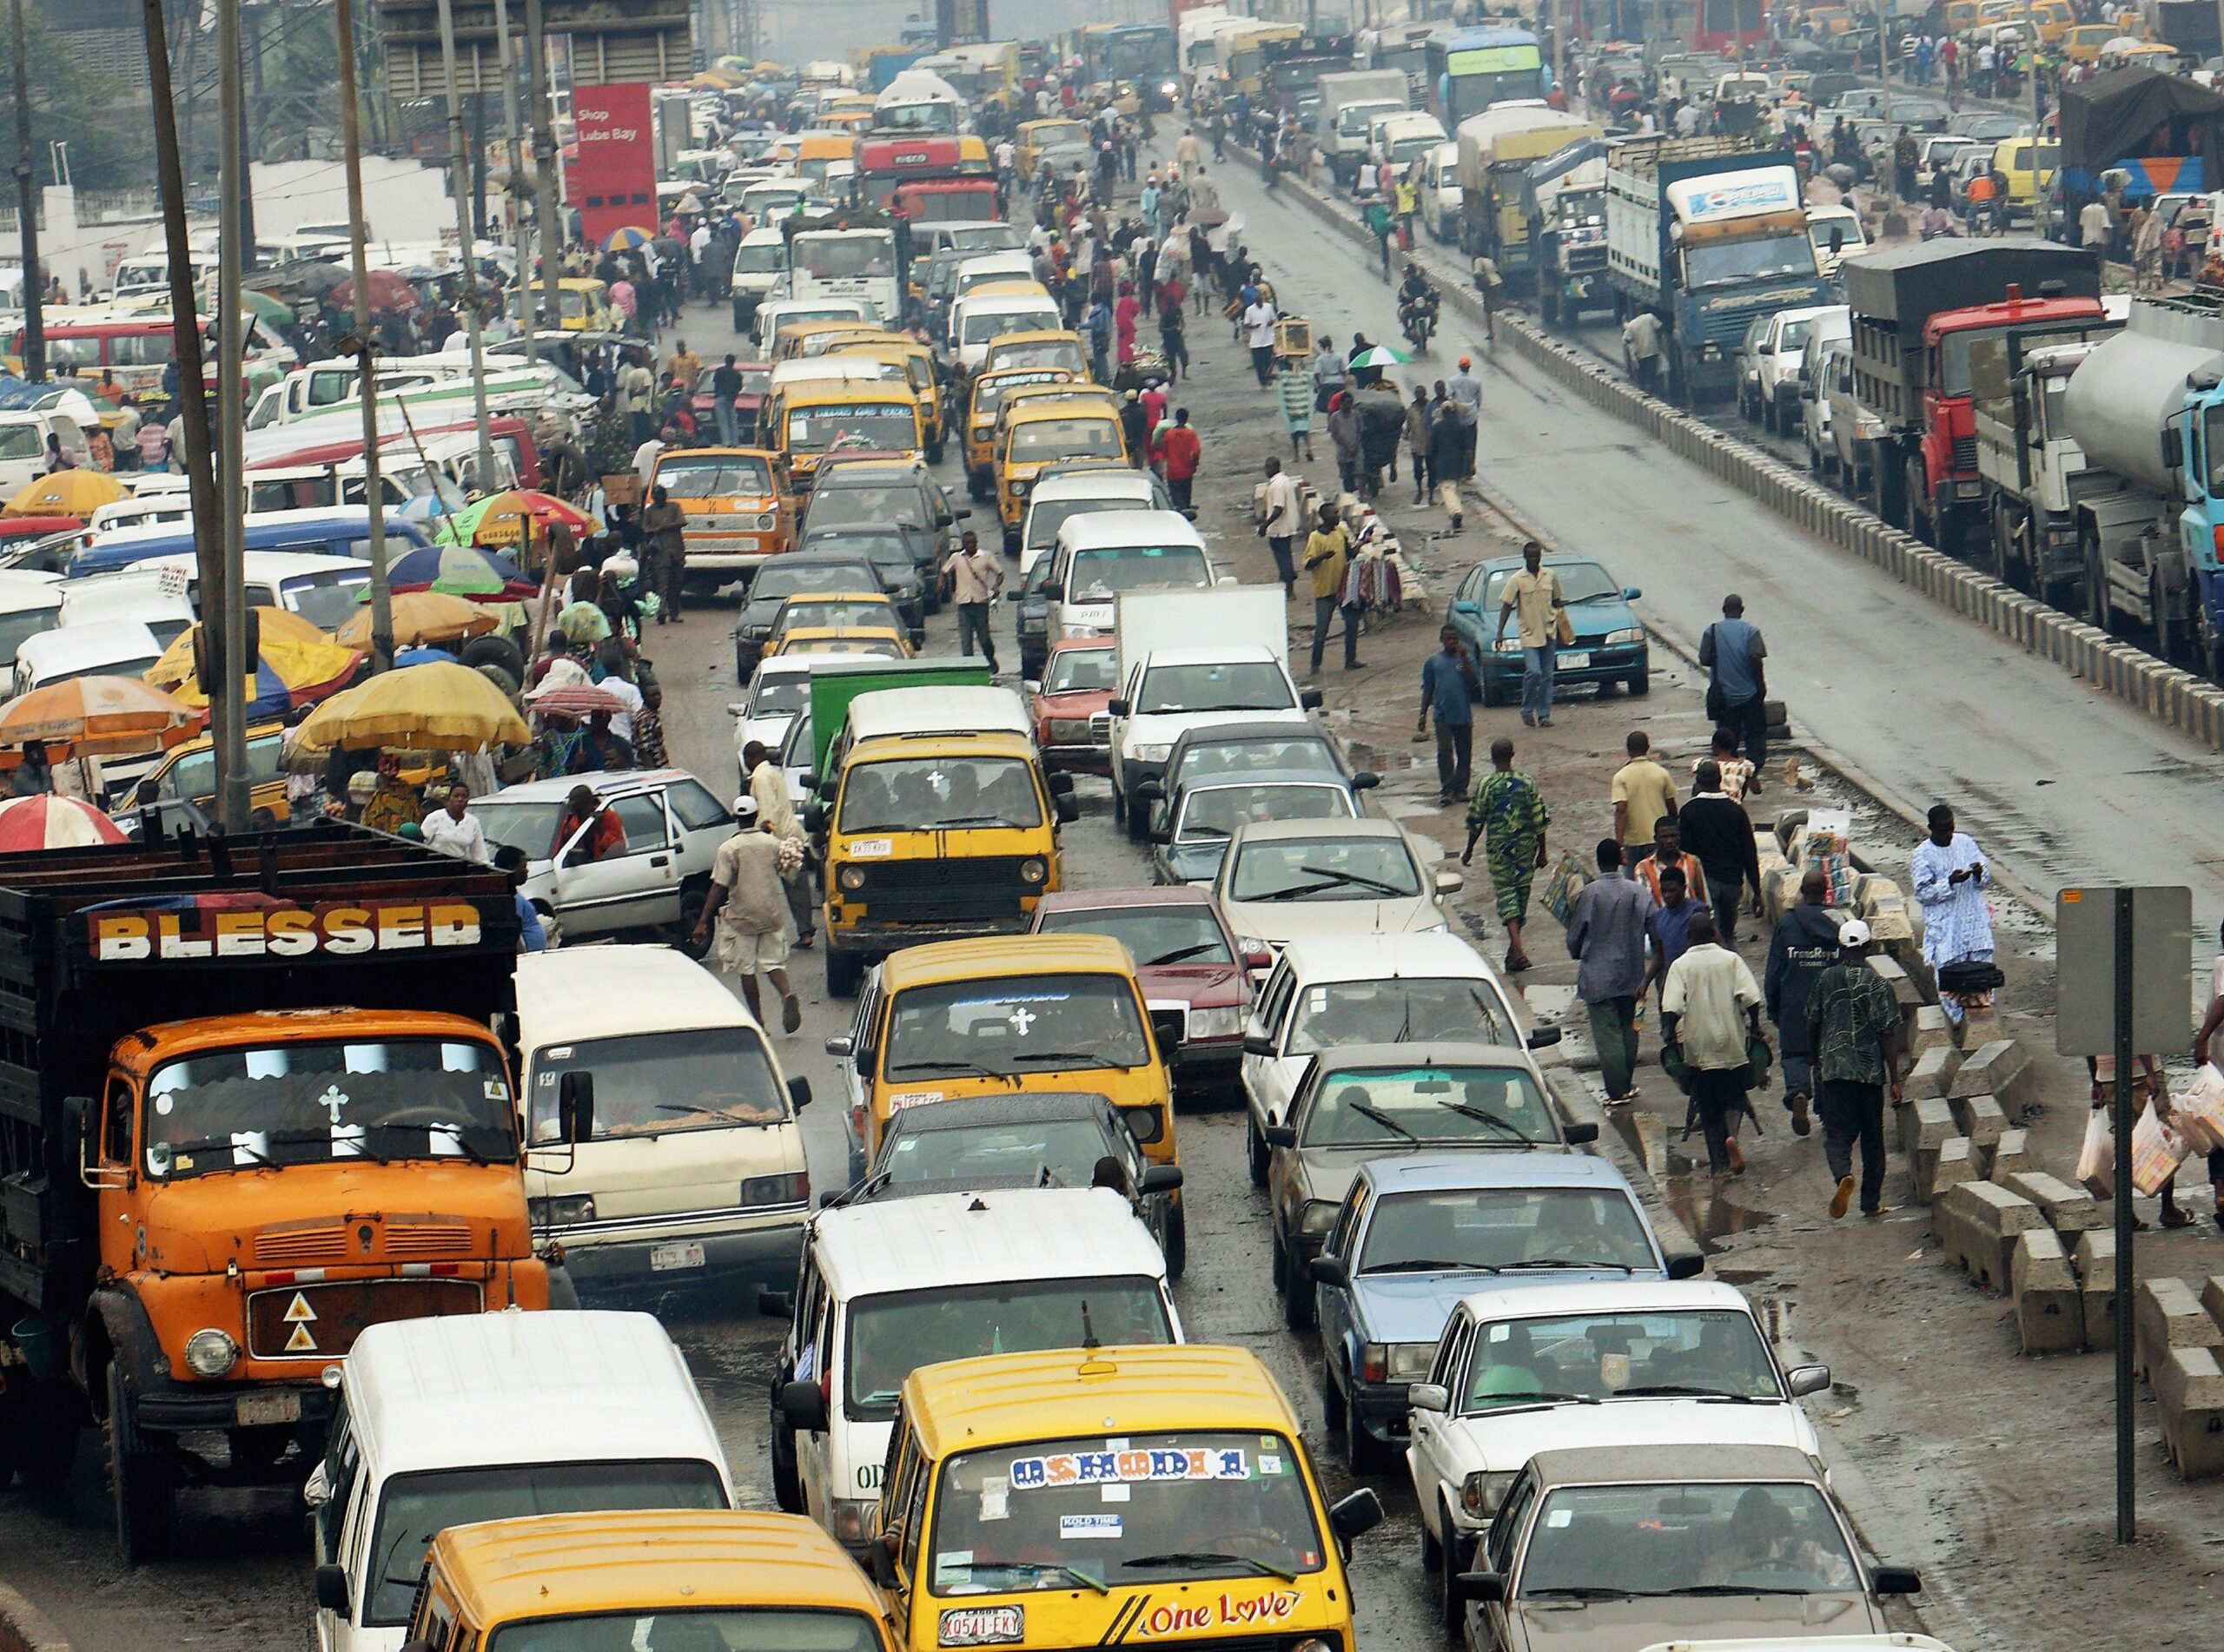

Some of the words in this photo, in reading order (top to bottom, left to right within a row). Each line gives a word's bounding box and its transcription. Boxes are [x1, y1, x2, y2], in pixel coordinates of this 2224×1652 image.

[578, 109, 609, 122] Shop
[579, 129, 610, 142] Lube
[612, 127, 637, 142] Bay
[98, 903, 481, 961] BLESSED
[1787, 946, 1840, 961] TransRoyal
[1013, 1450, 1208, 1486] OSHODI
[1220, 1451, 1247, 1477] 1
[1150, 1605, 1211, 1633] One
